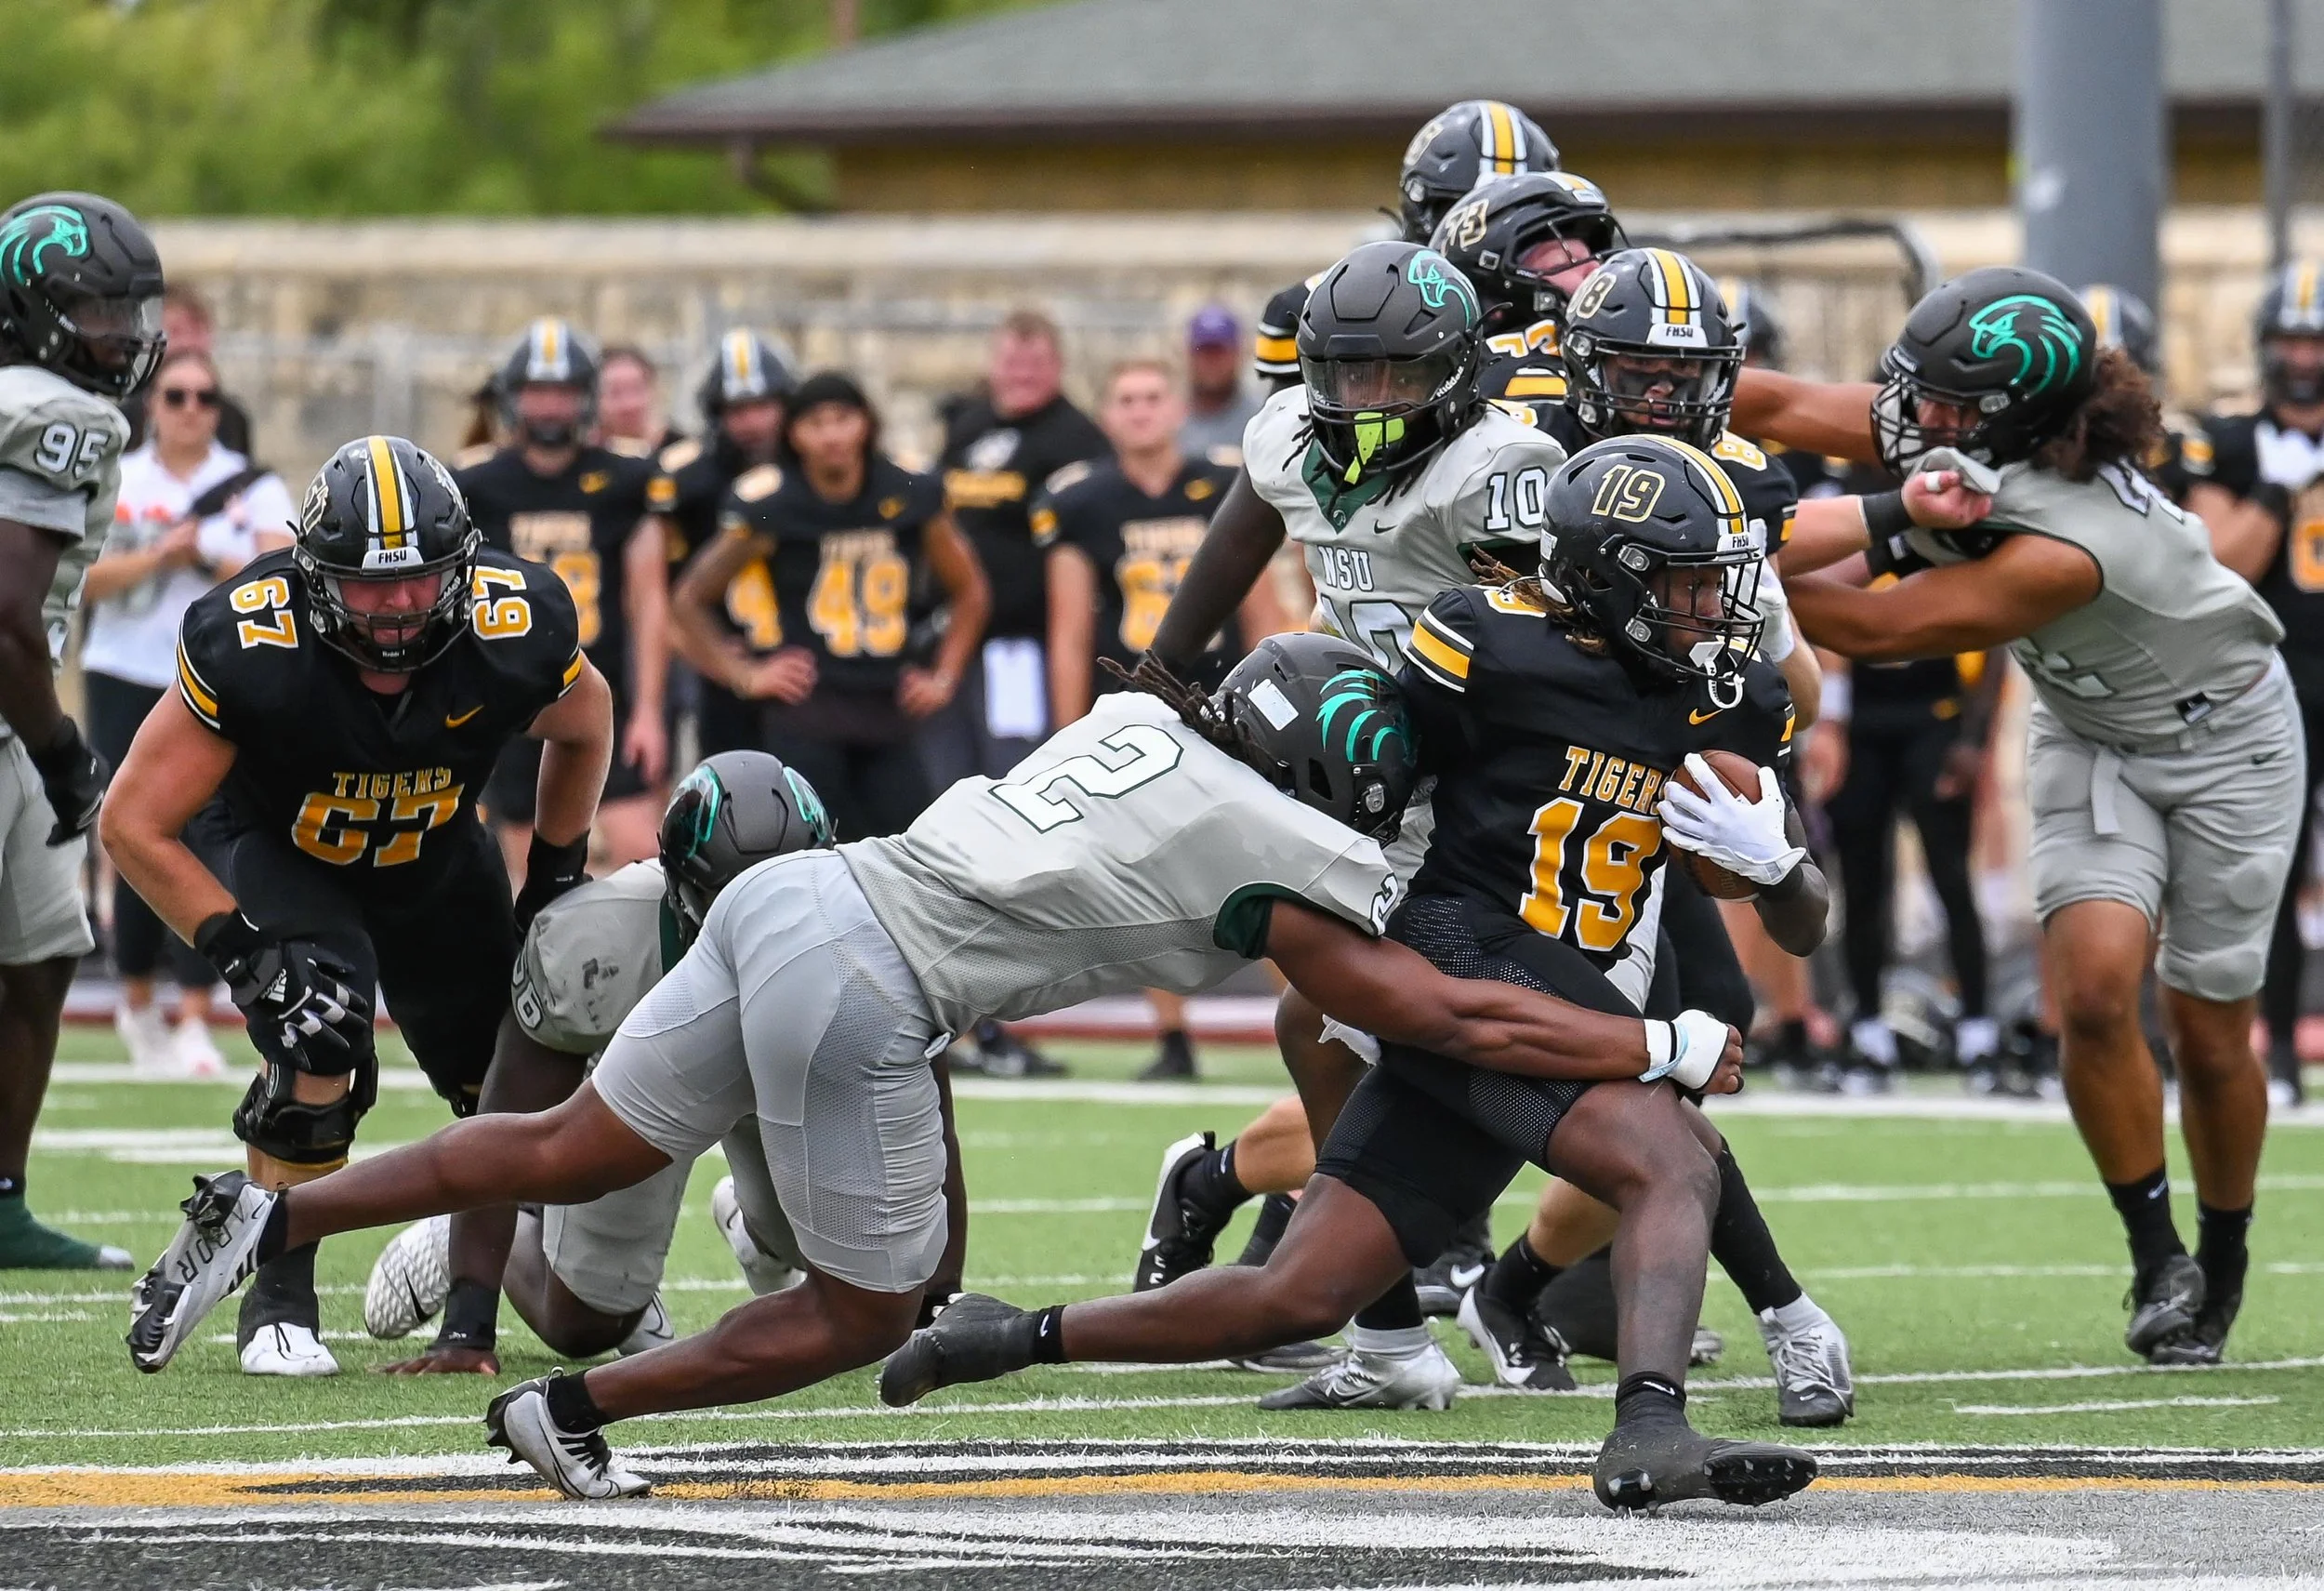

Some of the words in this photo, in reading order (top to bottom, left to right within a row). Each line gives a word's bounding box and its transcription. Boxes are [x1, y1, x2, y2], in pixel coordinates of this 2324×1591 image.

[1665, 325, 1695, 338] FHSU
[33, 419, 112, 482] 95
[1483, 465, 1548, 533] 10
[1591, 463, 1666, 524] 19
[378, 549, 408, 564] FHSU
[1317, 545, 1375, 592] NSU
[229, 576, 299, 649] 67
[466, 564, 533, 641] 67
[333, 766, 453, 800] TIGERS
[986, 723, 1185, 835] 2
[1558, 745, 1662, 815] TIGER
[291, 783, 465, 868] 67
[1517, 796, 1663, 952] 19
